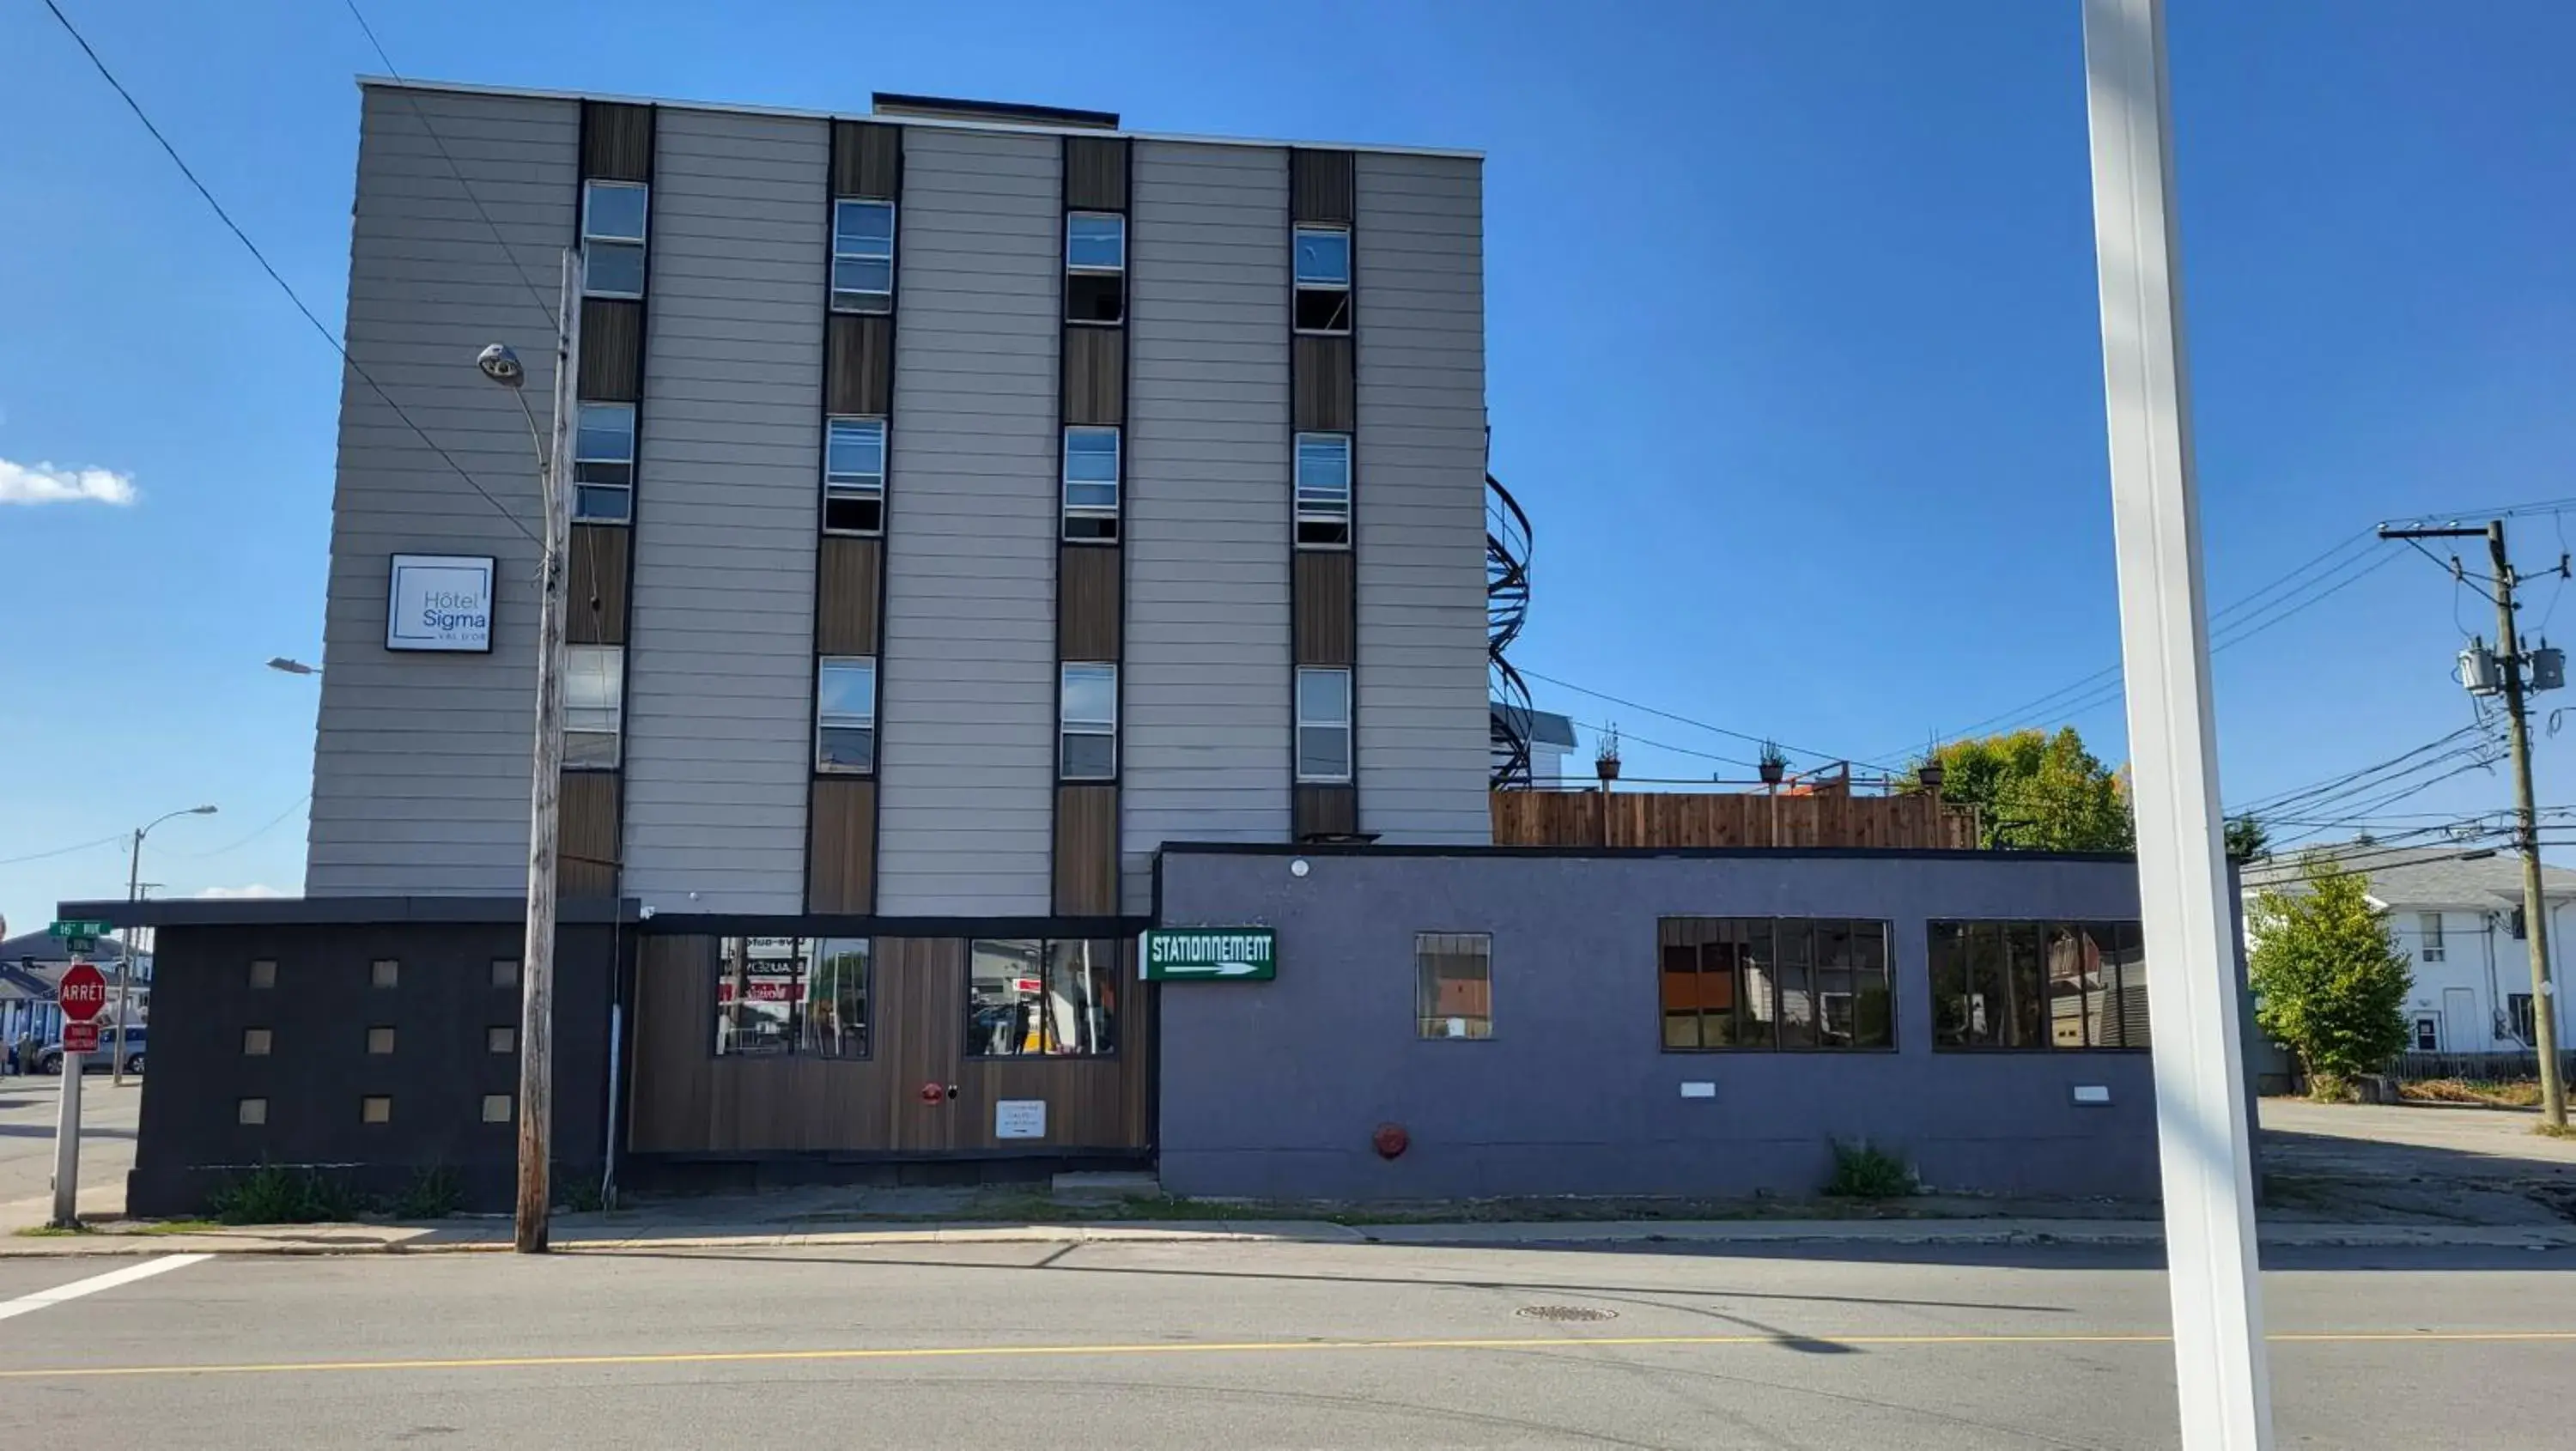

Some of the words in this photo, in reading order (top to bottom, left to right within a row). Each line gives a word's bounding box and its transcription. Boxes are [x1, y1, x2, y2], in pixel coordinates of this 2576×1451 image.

[425, 591, 478, 609] Hôtel
[423, 609, 485, 630] Sigma
[1152, 935, 1271, 962] STATIONNEMENT
[62, 982, 104, 1001] ARRÊT
